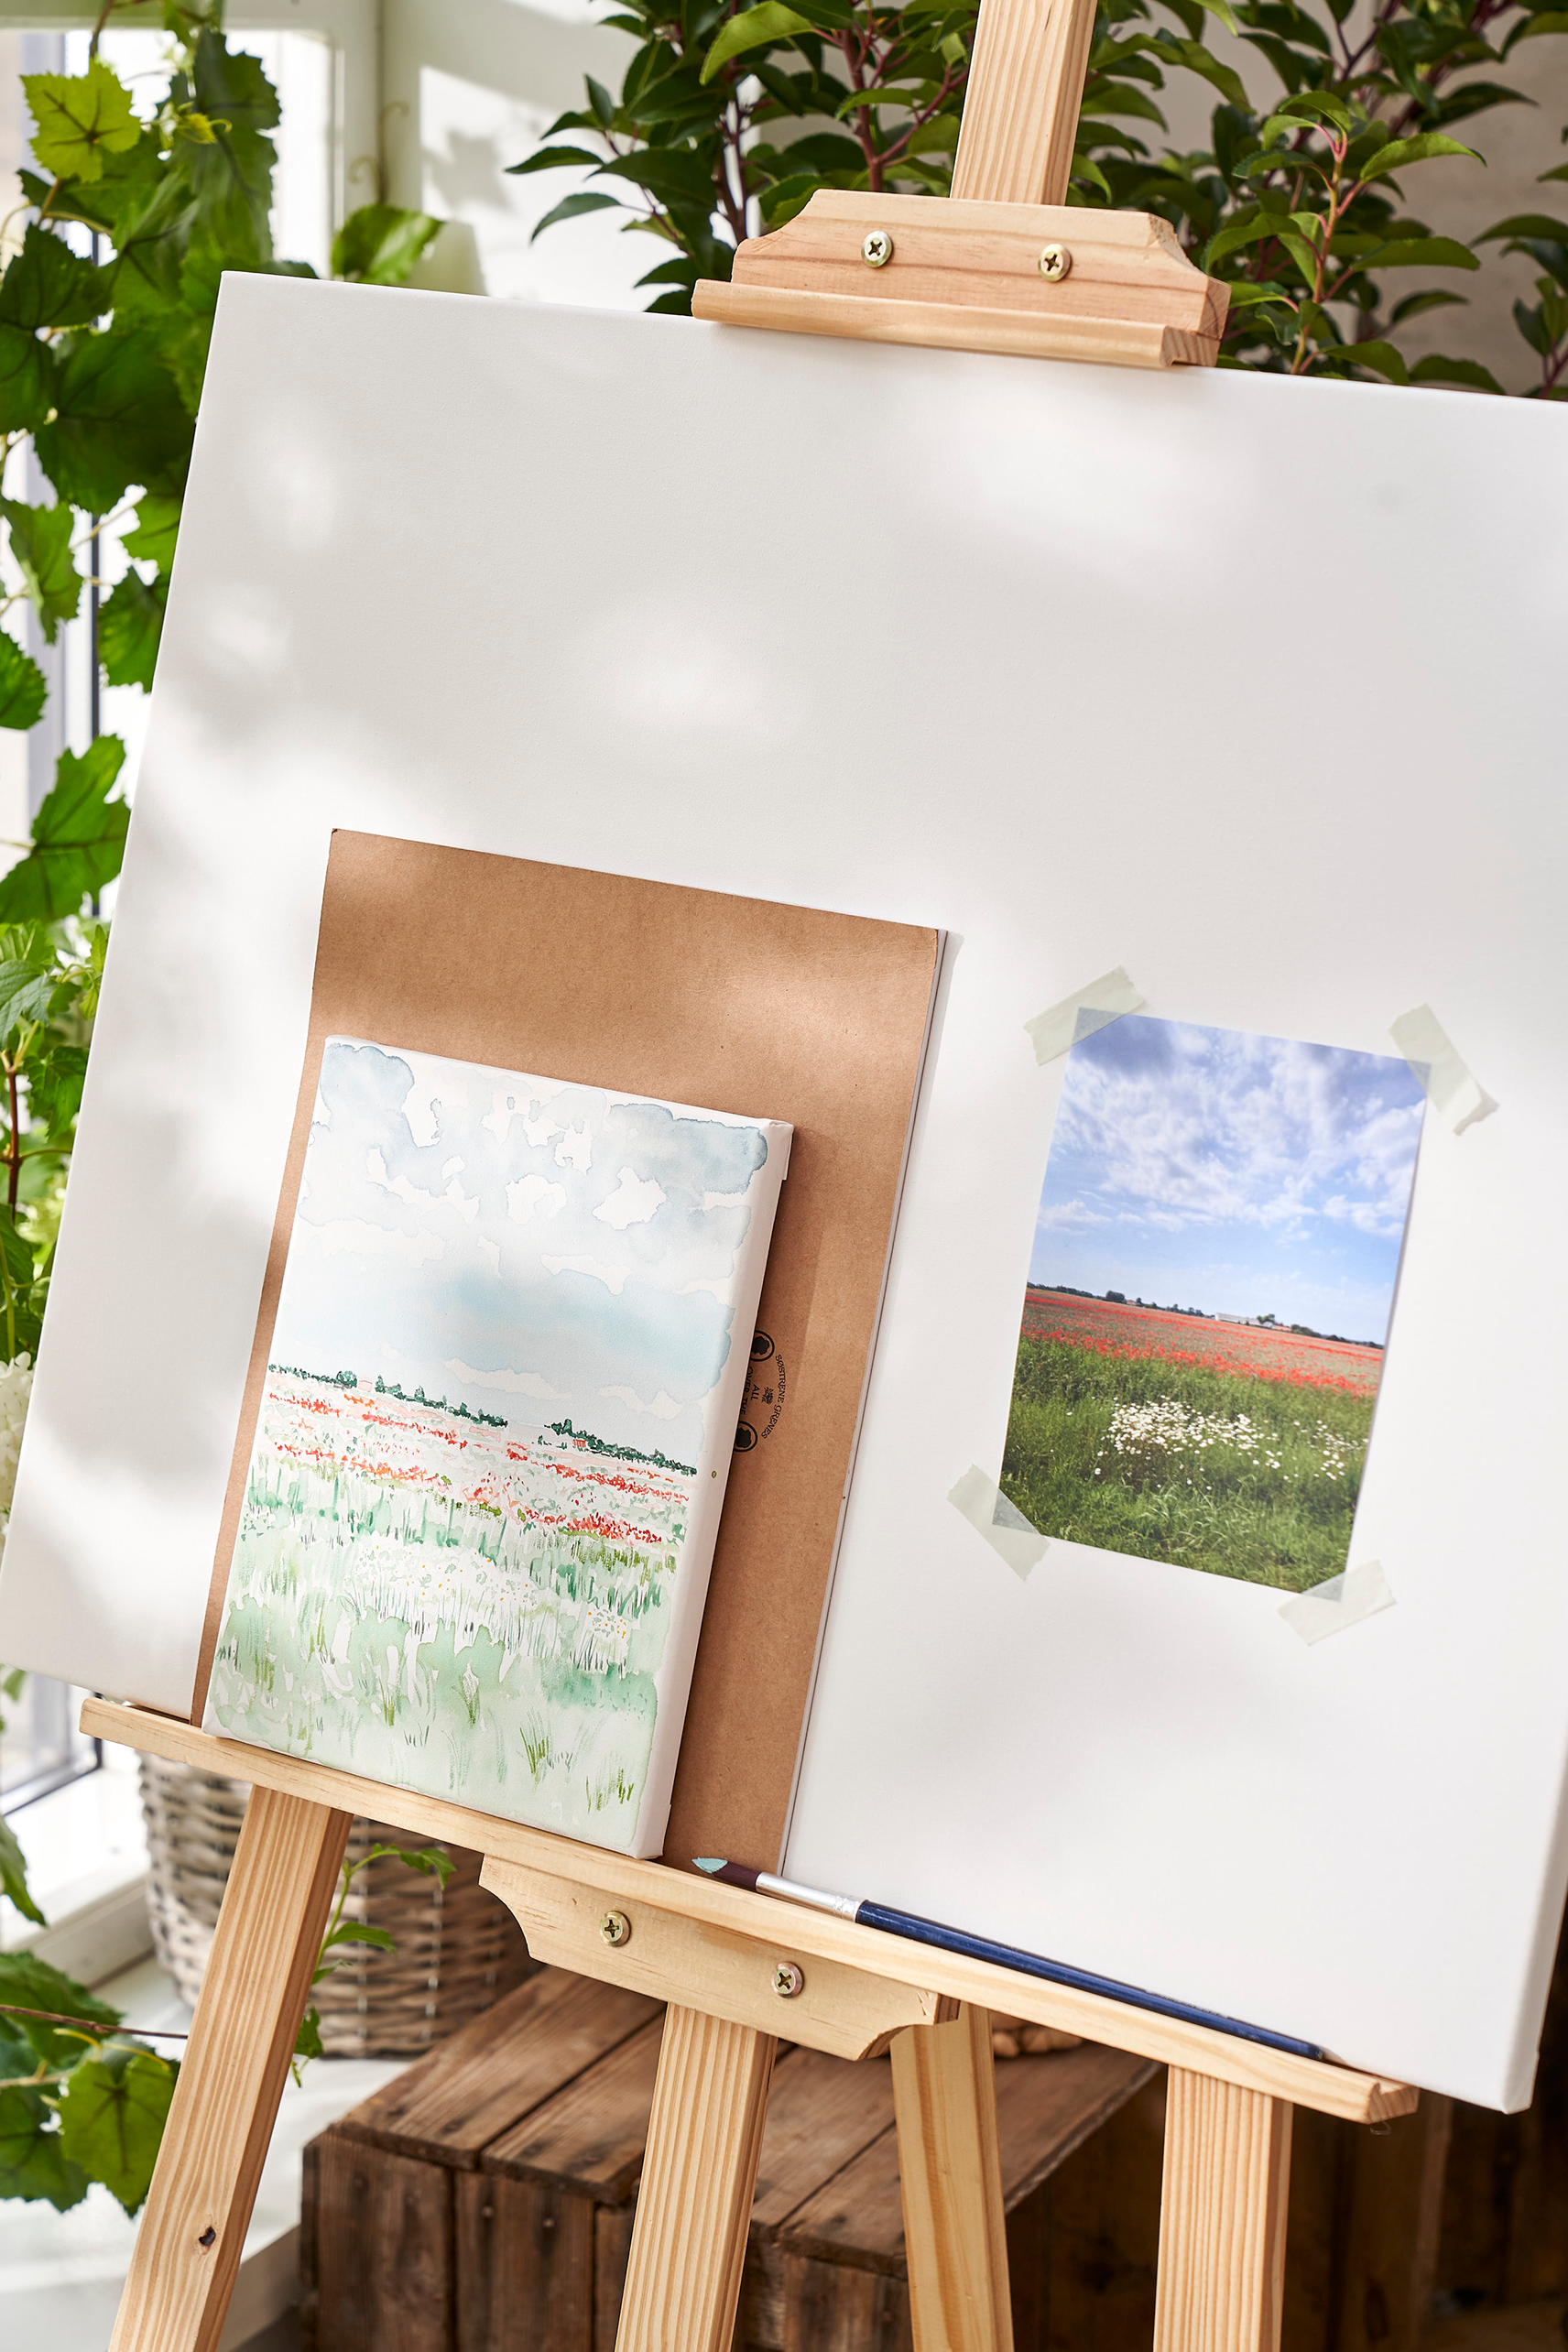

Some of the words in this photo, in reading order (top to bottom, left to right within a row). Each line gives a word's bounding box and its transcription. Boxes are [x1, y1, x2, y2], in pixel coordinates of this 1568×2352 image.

[750, 1384, 760, 1400] ALL
[776, 1354, 787, 1403] SØSTRENE
[761, 1404, 782, 1439] GRENES
